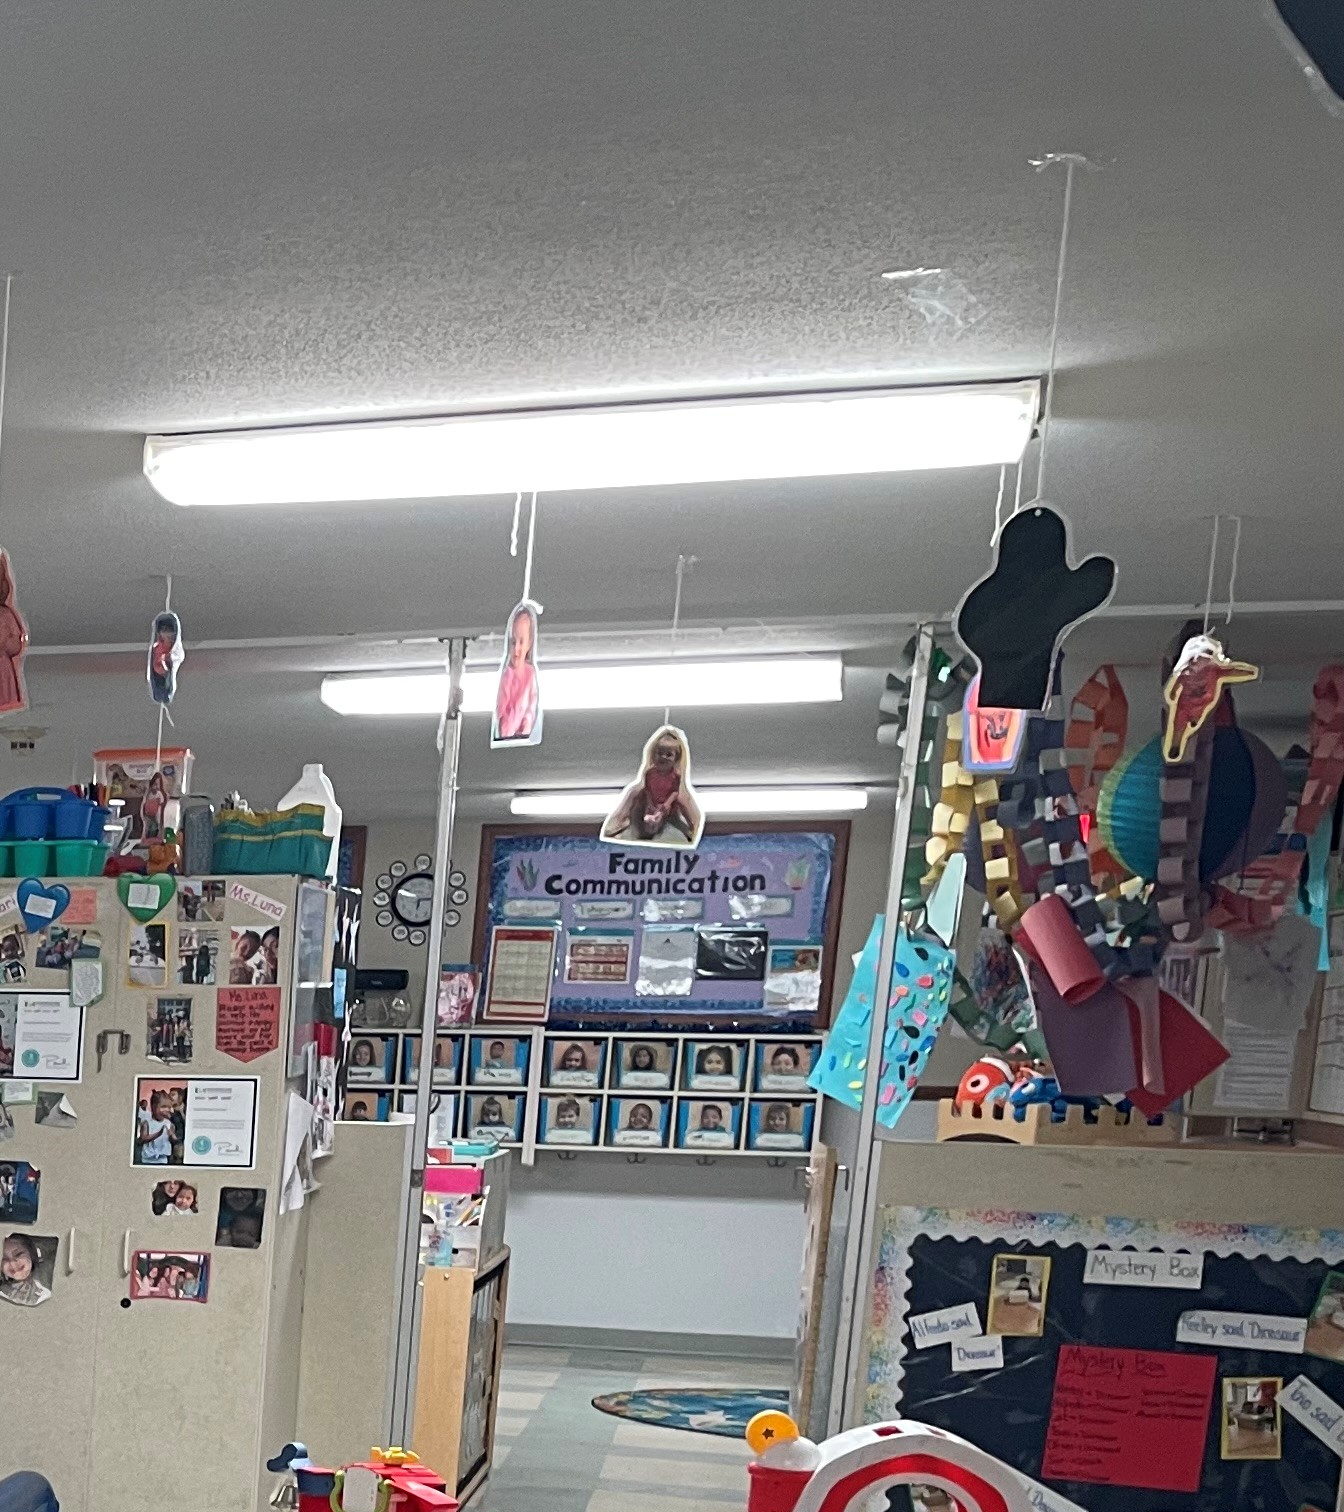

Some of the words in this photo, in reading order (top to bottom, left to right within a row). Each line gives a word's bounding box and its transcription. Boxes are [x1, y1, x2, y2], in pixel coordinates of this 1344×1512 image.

[608, 851, 700, 876] Family
[544, 870, 767, 896] Communication
[1090, 1254, 1156, 1281] Mystery
[1169, 1257, 1201, 1279] Box
[1065, 1346, 1125, 1380] Mystery
